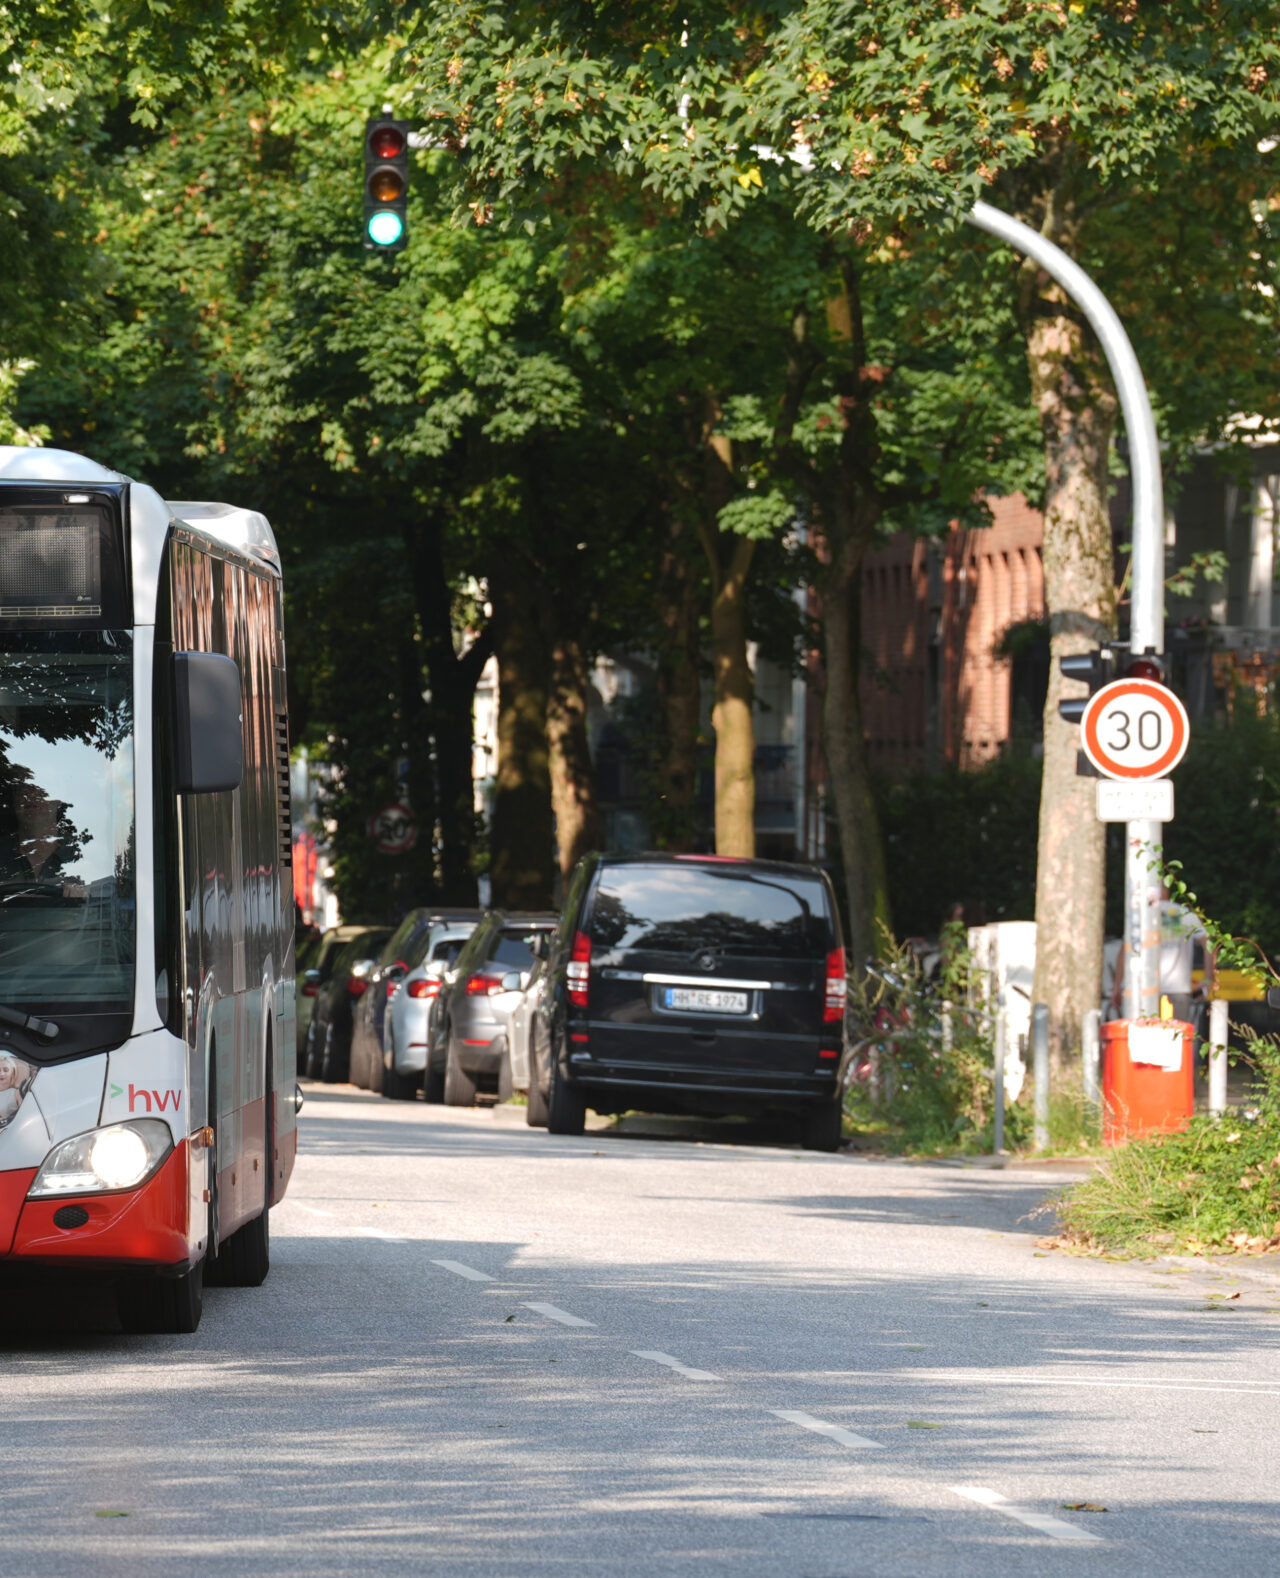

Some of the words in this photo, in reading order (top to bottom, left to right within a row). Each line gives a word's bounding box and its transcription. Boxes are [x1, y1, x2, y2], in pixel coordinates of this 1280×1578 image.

[1107, 710, 1162, 751] 30
[674, 990, 690, 1004] HH
[697, 992, 712, 1006] RE
